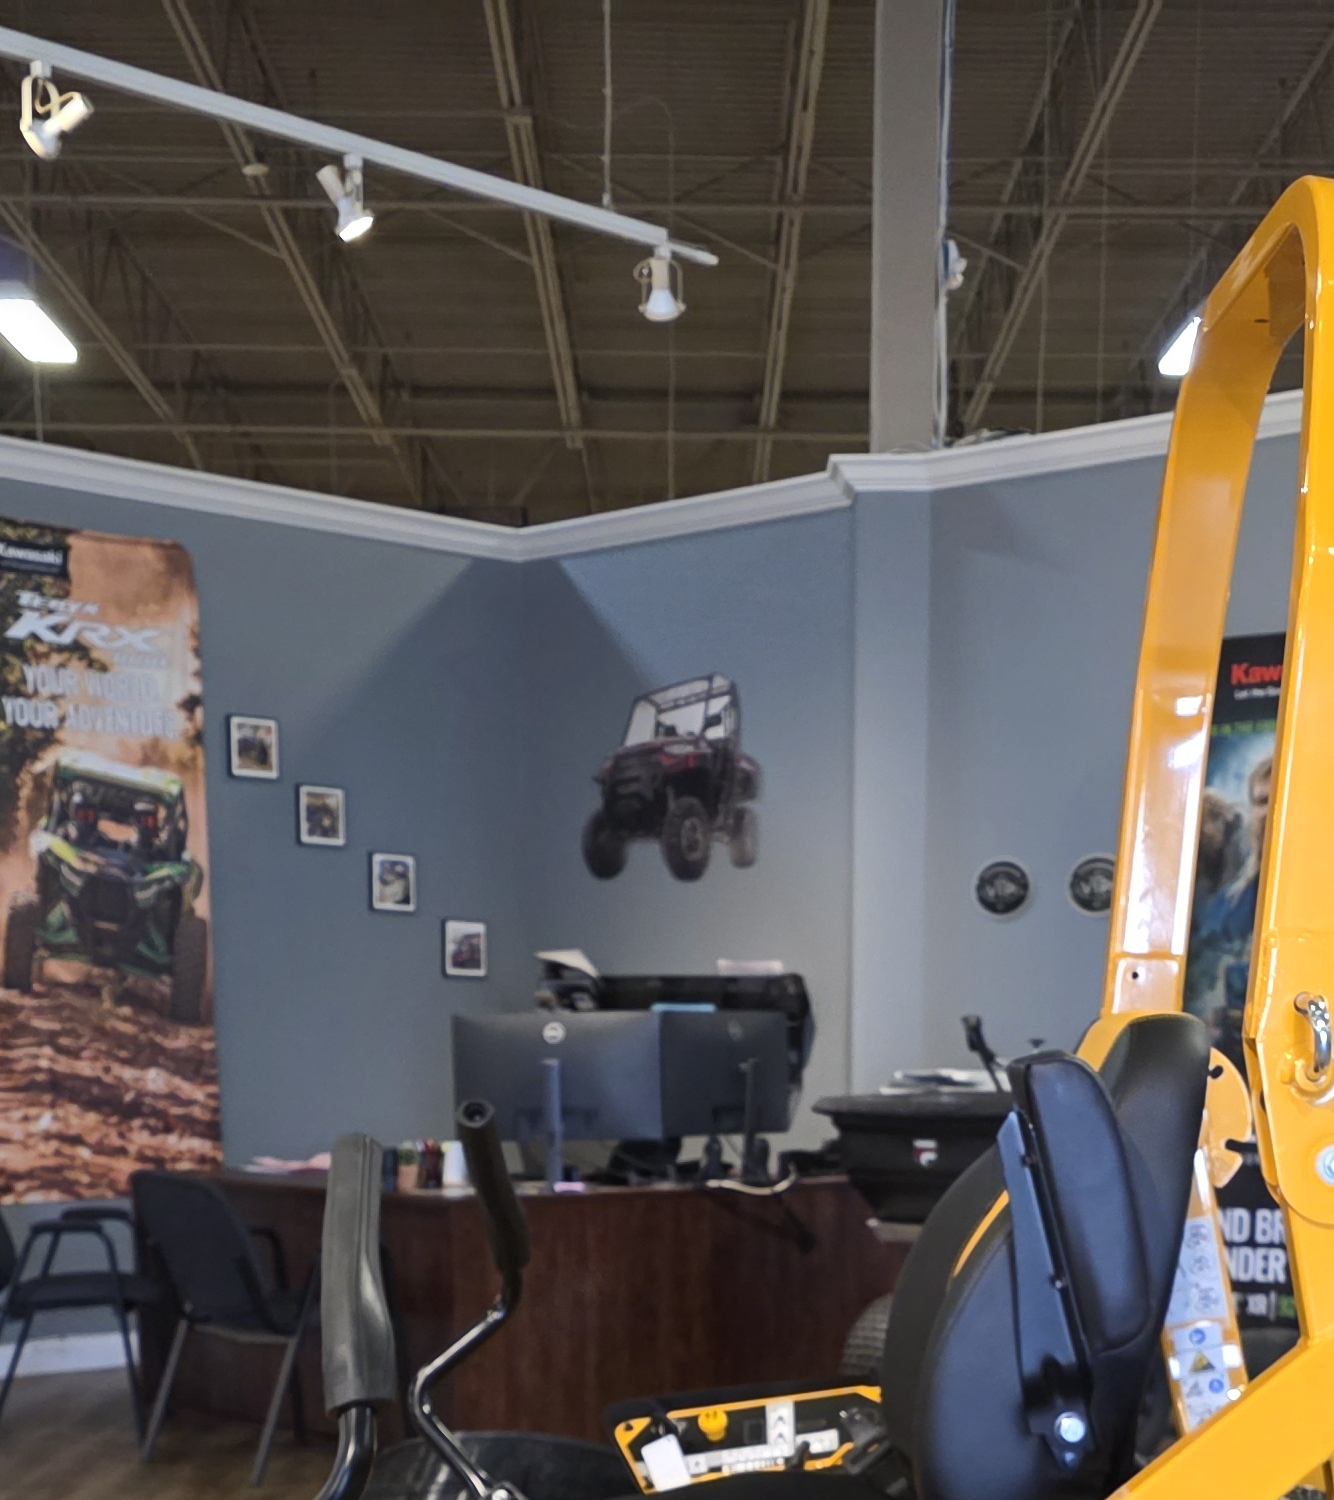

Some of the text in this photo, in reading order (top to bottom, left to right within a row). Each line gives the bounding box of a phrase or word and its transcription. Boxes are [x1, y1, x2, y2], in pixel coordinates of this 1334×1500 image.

[3, 612, 161, 652] KRX
[22, 663, 82, 698] YOUR
[1231, 662, 1284, 686] Kaw
[1, 697, 61, 730] YOUR
